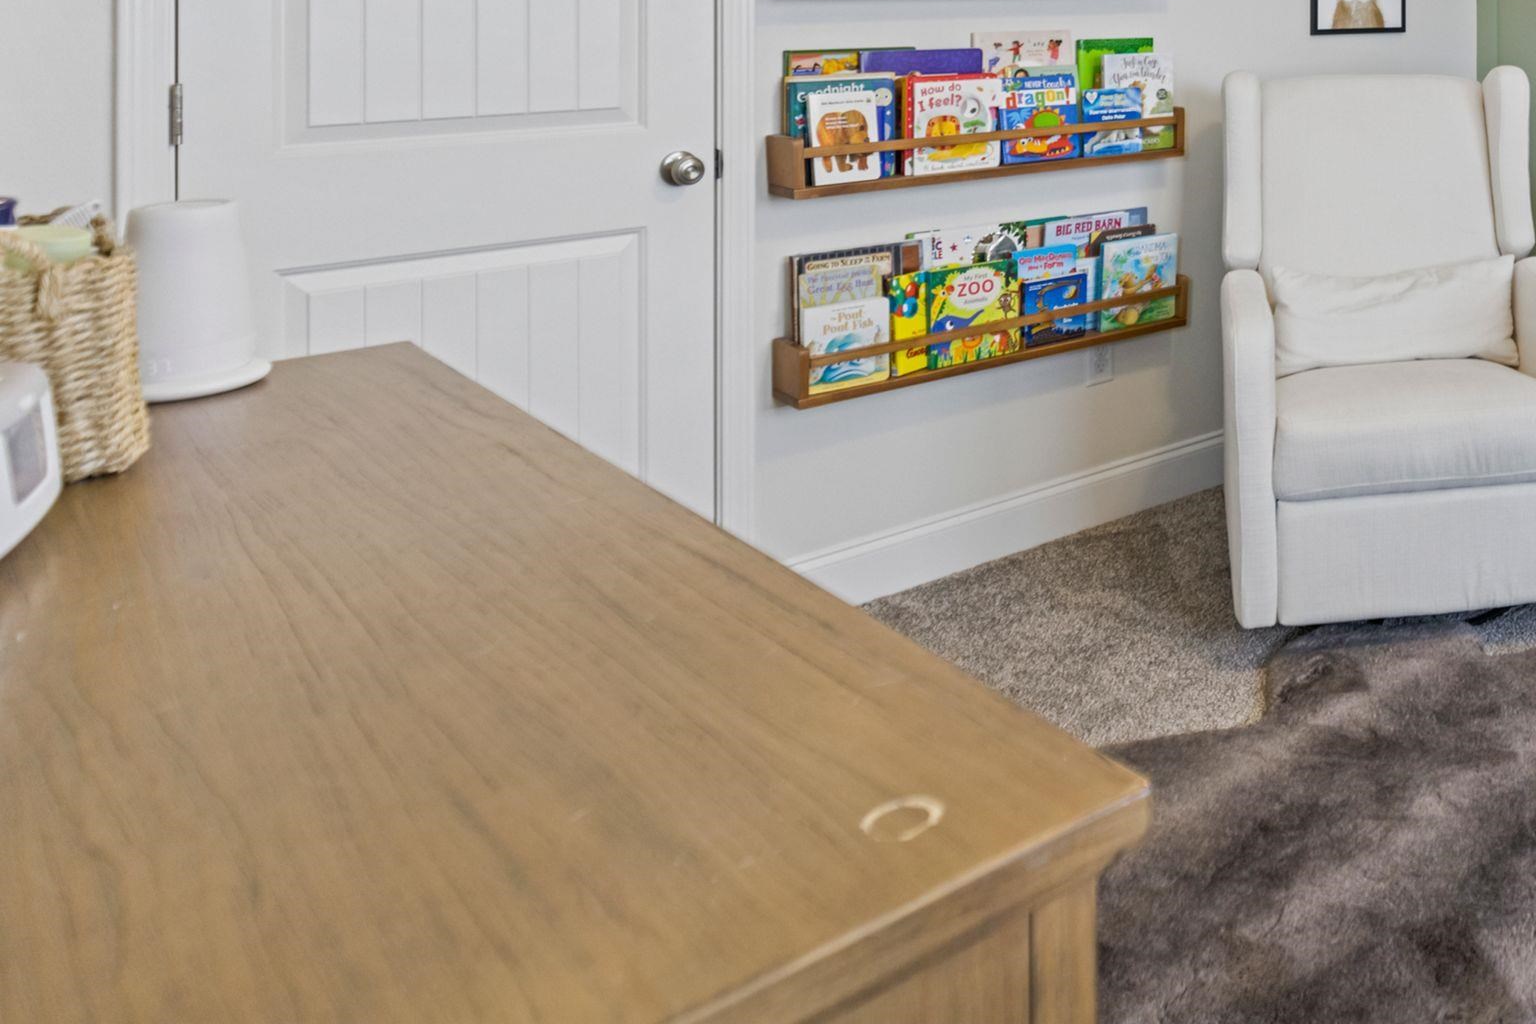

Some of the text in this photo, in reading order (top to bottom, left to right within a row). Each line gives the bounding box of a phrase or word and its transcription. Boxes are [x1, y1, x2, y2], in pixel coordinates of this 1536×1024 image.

[948, 82, 961, 91] do
[918, 93, 962, 112] I feel?
[1006, 86, 1070, 109] dragon!
[1056, 217, 1121, 236] BIG RED BARN
[957, 279, 994, 297] ZOO
